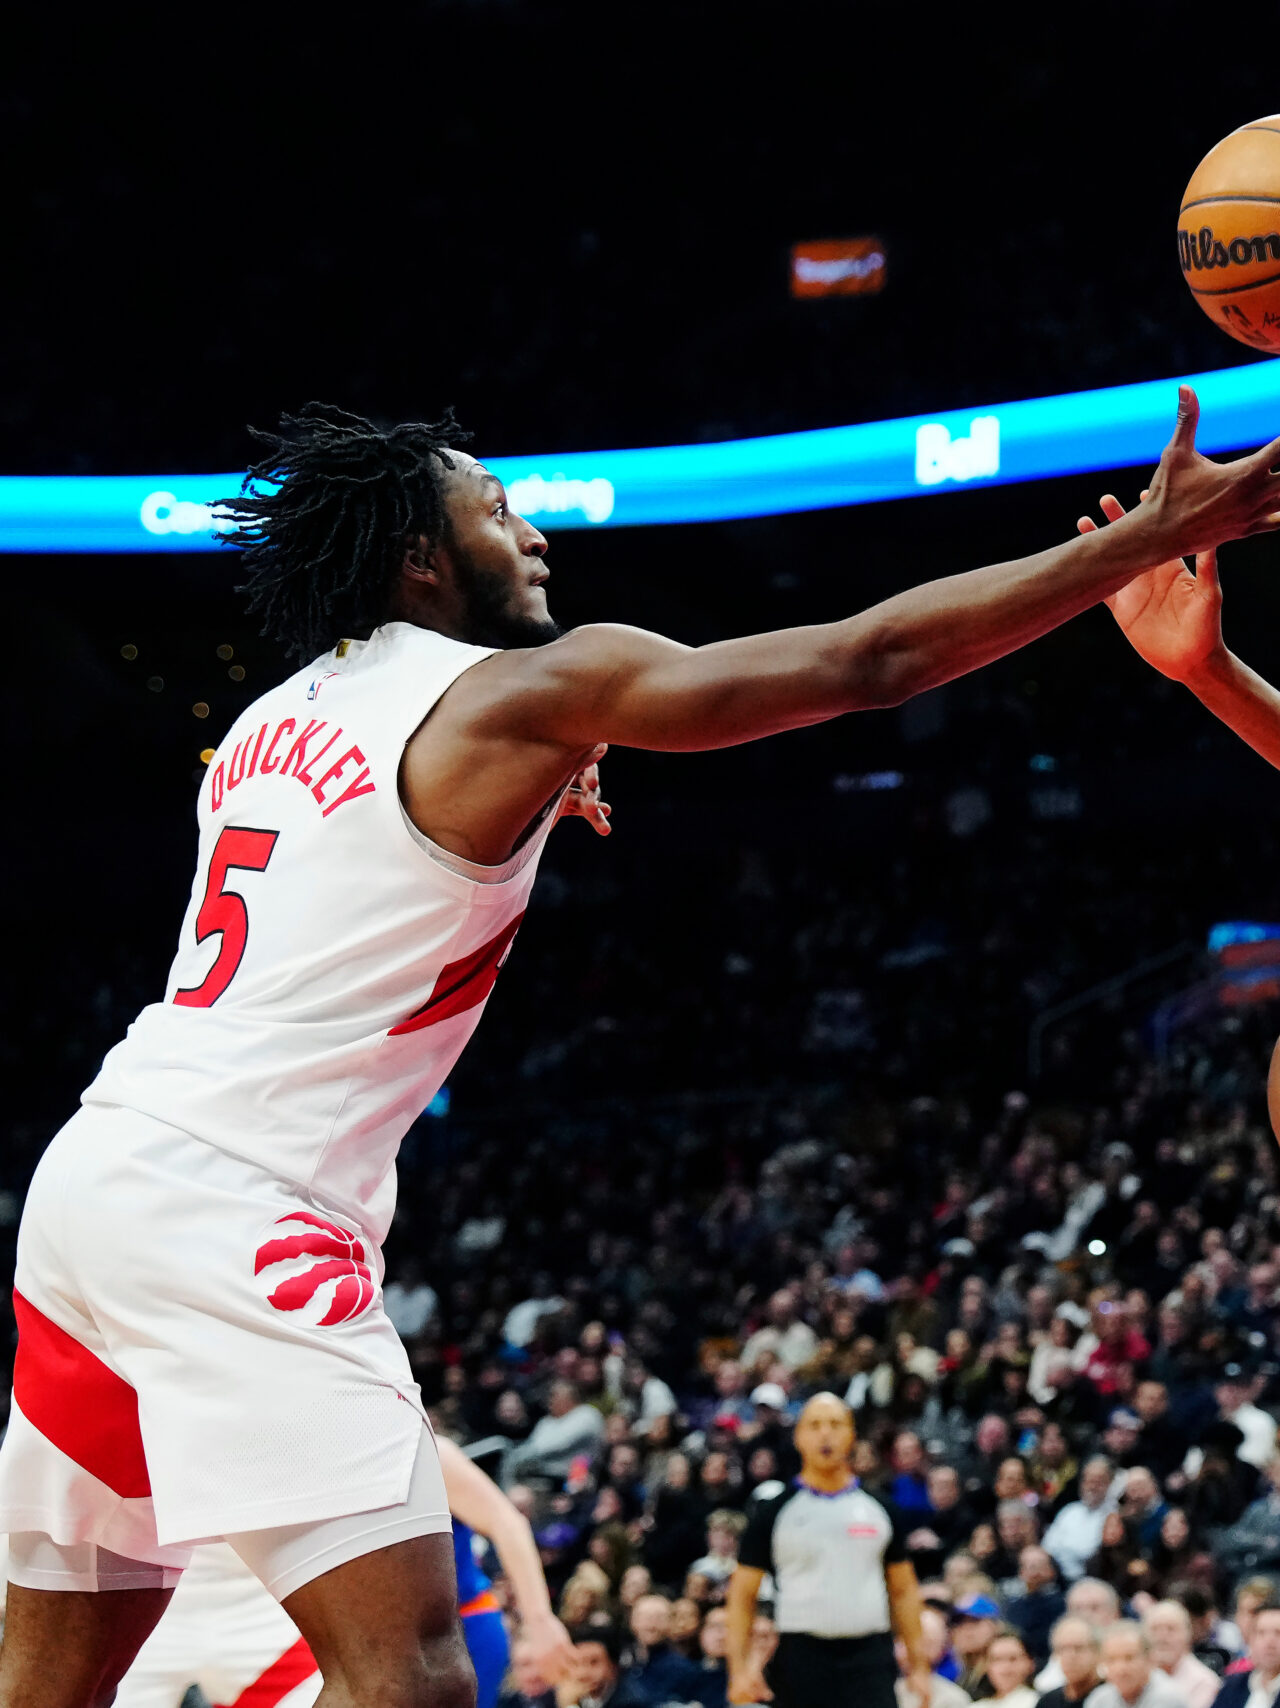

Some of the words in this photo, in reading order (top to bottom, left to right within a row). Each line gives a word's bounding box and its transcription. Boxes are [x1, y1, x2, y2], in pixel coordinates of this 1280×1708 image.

[916, 416, 1000, 485] Bell
[211, 717, 376, 818] QUICKLEY
[172, 825, 280, 1008] 5
